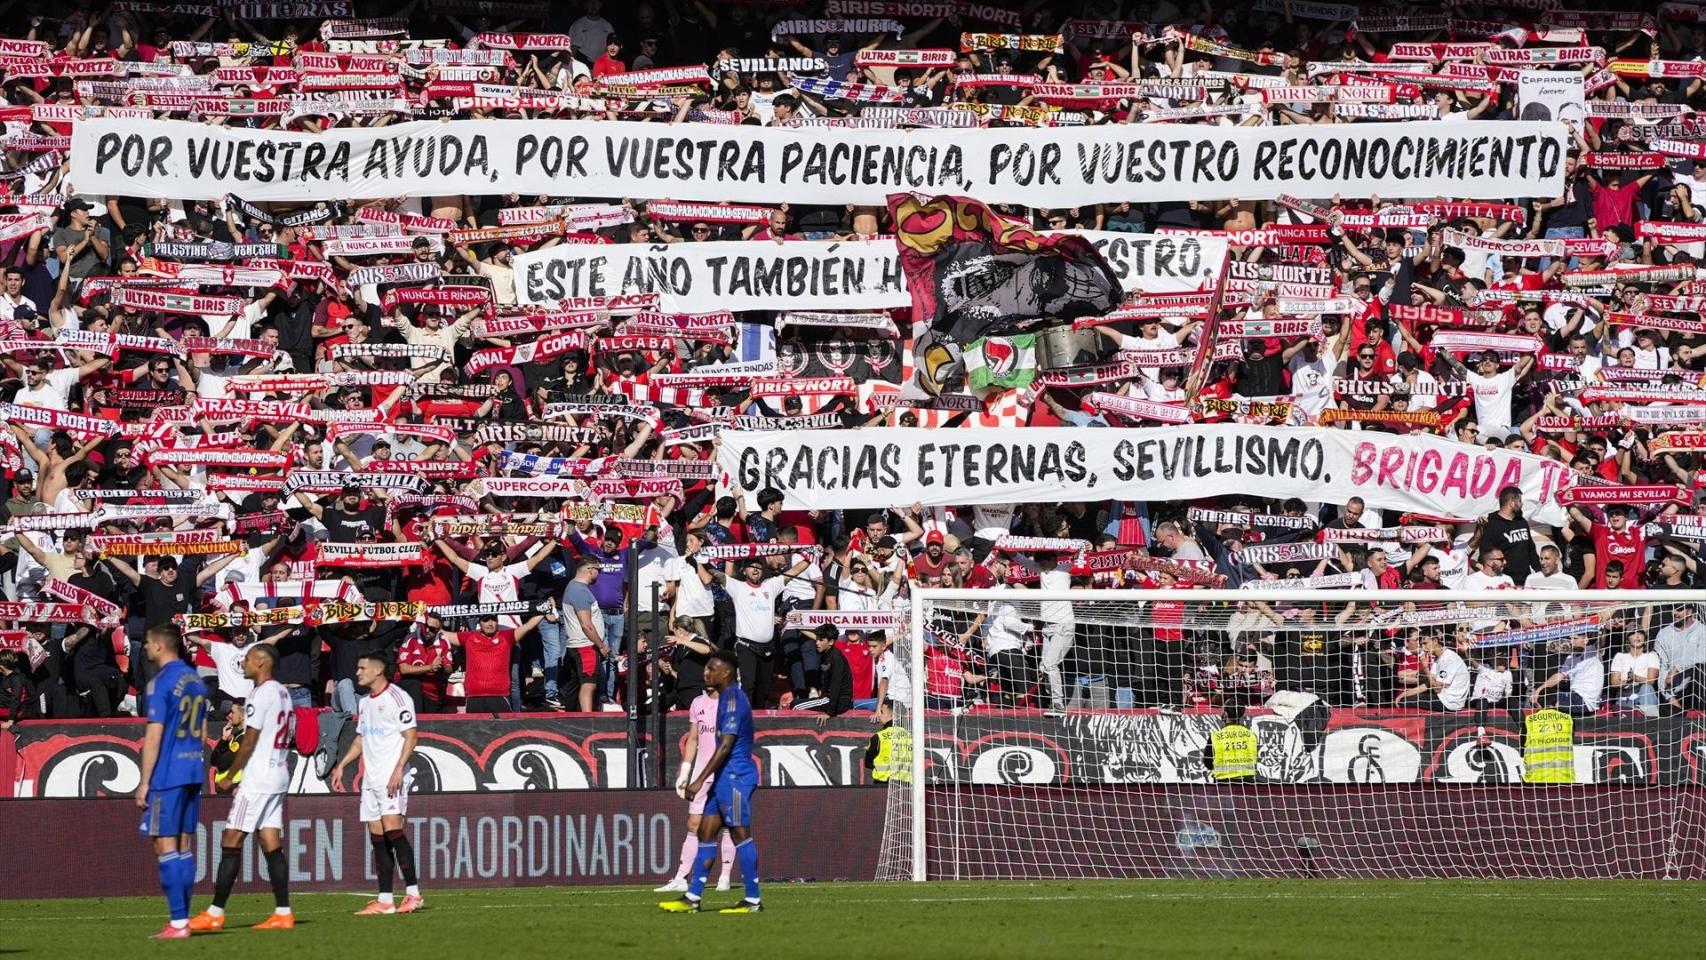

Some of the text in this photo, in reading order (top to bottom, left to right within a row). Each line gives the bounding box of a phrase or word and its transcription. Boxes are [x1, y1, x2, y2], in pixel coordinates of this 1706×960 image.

[777, 20, 826, 34] BIRIS
[527, 35, 570, 47] NORTE
[861, 52, 948, 62] ULTRAS BIRIS
[1395, 45, 1432, 57] BIRIS
[1489, 48, 1592, 62] ULTRAS BIRIS
[65, 61, 114, 79] NORTE
[304, 56, 337, 70] BIRIS
[718, 57, 825, 73] SEVILLANOS
[218, 69, 253, 84] BIRIS
[1449, 64, 1488, 79] BIRIS
[1521, 76, 1584, 85] CAPARROS
[481, 87, 512, 95] SEVILLA
[1032, 84, 1136, 97] ULTRAS BIRIS
[1271, 87, 1389, 100] BIRIS NORTE
[37, 106, 84, 119] BIRIS
[257, 101, 291, 113] BIRIS
[1632, 125, 1703, 139] SEVILLA
[1659, 139, 1700, 155] BIRIS
[95, 132, 1560, 192] POR VUESTRA AYUDA, POR VUESTRA PACIENCIA, POR VUESTRO RECONOCIMIENTO
[1593, 155, 1656, 165] Sevilla f.c.
[361, 207, 454, 231] BIRIS NORTE
[502, 210, 545, 224] BIRIS
[1378, 213, 1430, 228] NORTE
[1422, 206, 1519, 221] SEVILLA FC
[1307, 230, 1318, 240] TE
[346, 241, 394, 252] NUNCA ME
[1465, 236, 1542, 254] SUPERCOPA
[527, 242, 866, 302] ESTE AÑO TAMBIÉN
[1272, 264, 1332, 284] NORTE
[402, 290, 450, 303] NUNCA TE
[1282, 285, 1330, 299] NORTE
[124, 293, 226, 312] ULTRAS BIRIS
[486, 311, 596, 334] BIRIS NORTE
[637, 311, 735, 327] BIRIS NORTE
[1635, 314, 1704, 332] MARADONA
[1273, 322, 1309, 334] BIRIS
[68, 330, 110, 345] BIRIS
[116, 335, 166, 351] NORTE
[599, 337, 672, 350] ALGABA
[471, 335, 581, 371] FINAL COPA
[1126, 351, 1160, 366] Sevilla
[1161, 350, 1181, 364] F.C.
[744, 361, 775, 373] RINDAS
[1096, 363, 1131, 380] BIRIS
[1337, 380, 1394, 397] BIRIS
[1204, 399, 1239, 414] BIRIS
[8, 405, 107, 433] BIRIS NORTE
[1322, 408, 1438, 425] SEVILLA SOMOS NOSOTROS
[1539, 415, 1616, 427] BORO SEVILLA
[474, 425, 529, 448] BIRIS
[738, 435, 1523, 501] GRACIAS ETERNAS, SEVILLISMO. BRIGADA
[288, 472, 421, 492] ULTRAS SEVILLA
[486, 480, 570, 494] SUPERCOPA
[639, 480, 684, 496] NORTE
[1618, 489, 1630, 500] MI
[1631, 488, 1672, 500] SEVILLA!
[1192, 508, 1314, 530] BIRIS NORTE
[1326, 528, 1378, 541] BIRIS
[1503, 528, 1529, 543] VANS
[110, 540, 240, 559] SEVILLA SOMOS NOSOTROS
[323, 544, 422, 556] SEVILLA FÚTBOL CLUB
[708, 543, 751, 559] BIRIS
[50, 578, 80, 605] BIRIS
[0, 604, 63, 619] SEVILLA
[324, 603, 364, 620] BIRIS
[478, 601, 530, 616] GITANOS
[188, 613, 229, 630] BIRIS
[808, 615, 870, 625] NUNCA ME
[177, 694, 208, 739] 20
[1224, 741, 1249, 752] 2155
[364, 813, 673, 886] ETRAORDINARIO
